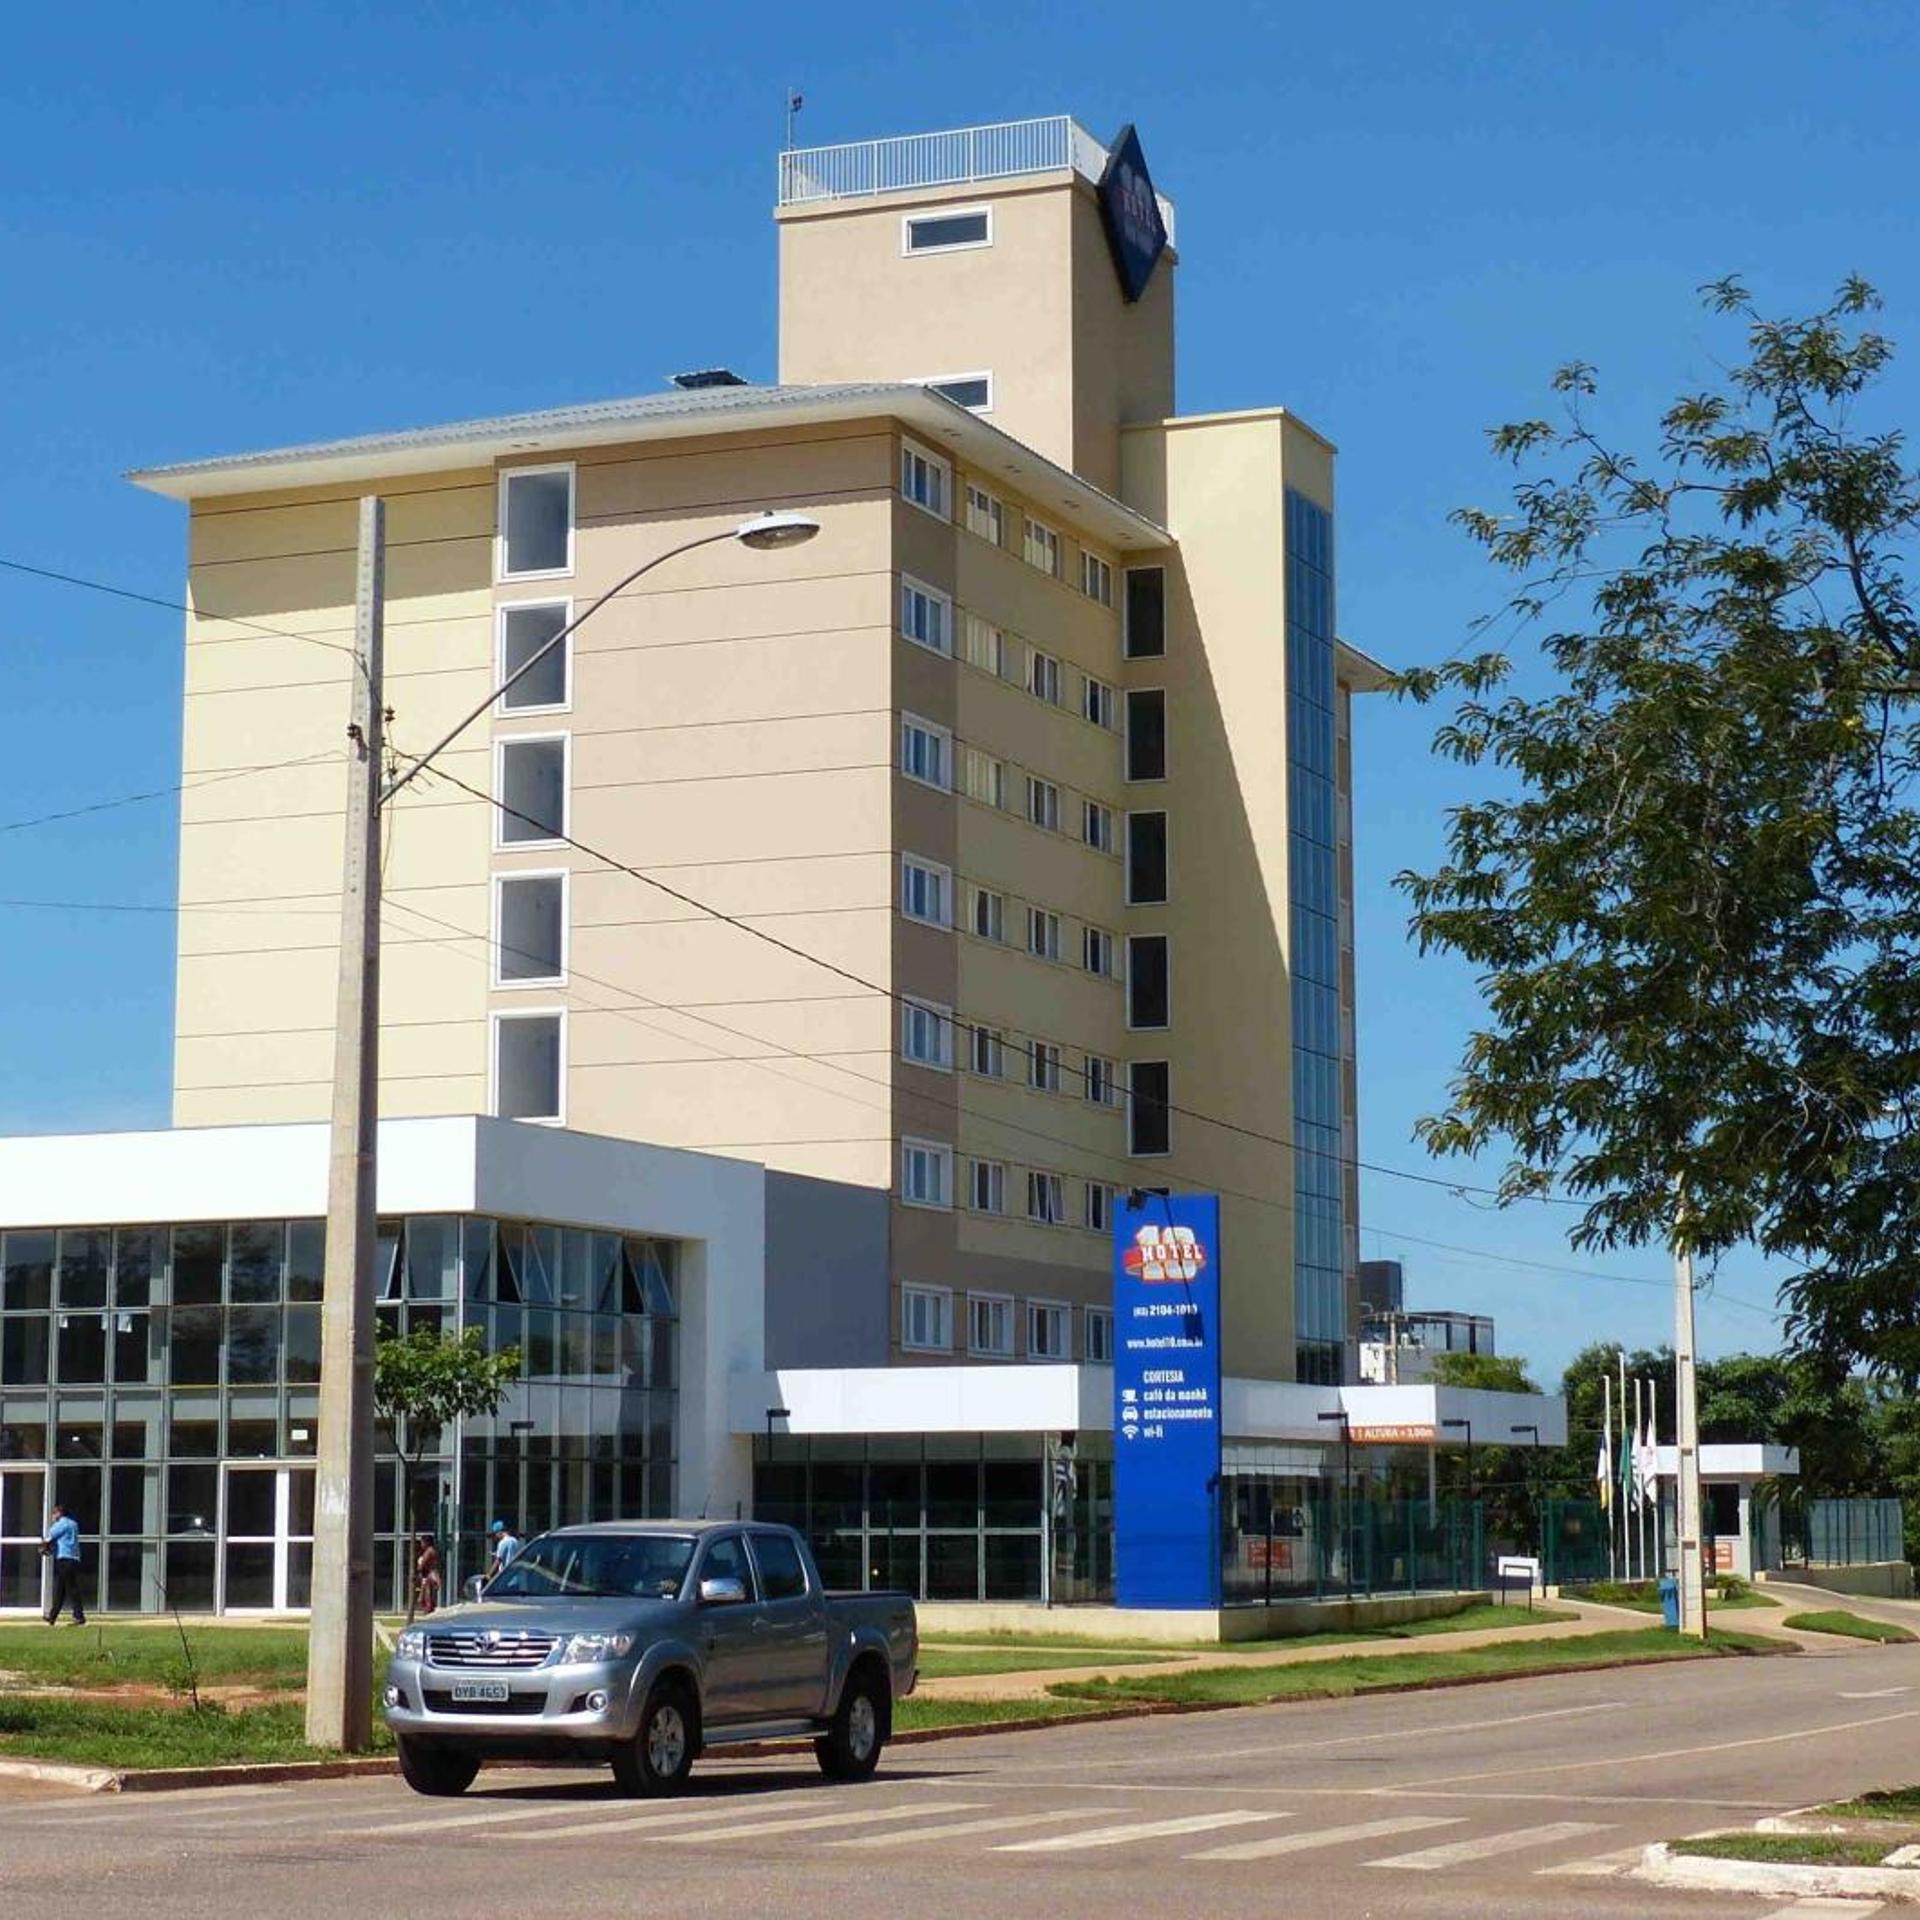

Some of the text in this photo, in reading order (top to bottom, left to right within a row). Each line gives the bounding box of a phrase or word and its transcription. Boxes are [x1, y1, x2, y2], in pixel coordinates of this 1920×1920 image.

[1142, 1243, 1203, 1261] HOTEL
[1143, 1370, 1184, 1384] CORTESIA
[1143, 1388, 1207, 1401] café da manhã
[1143, 1407, 1213, 1420] estacionamento
